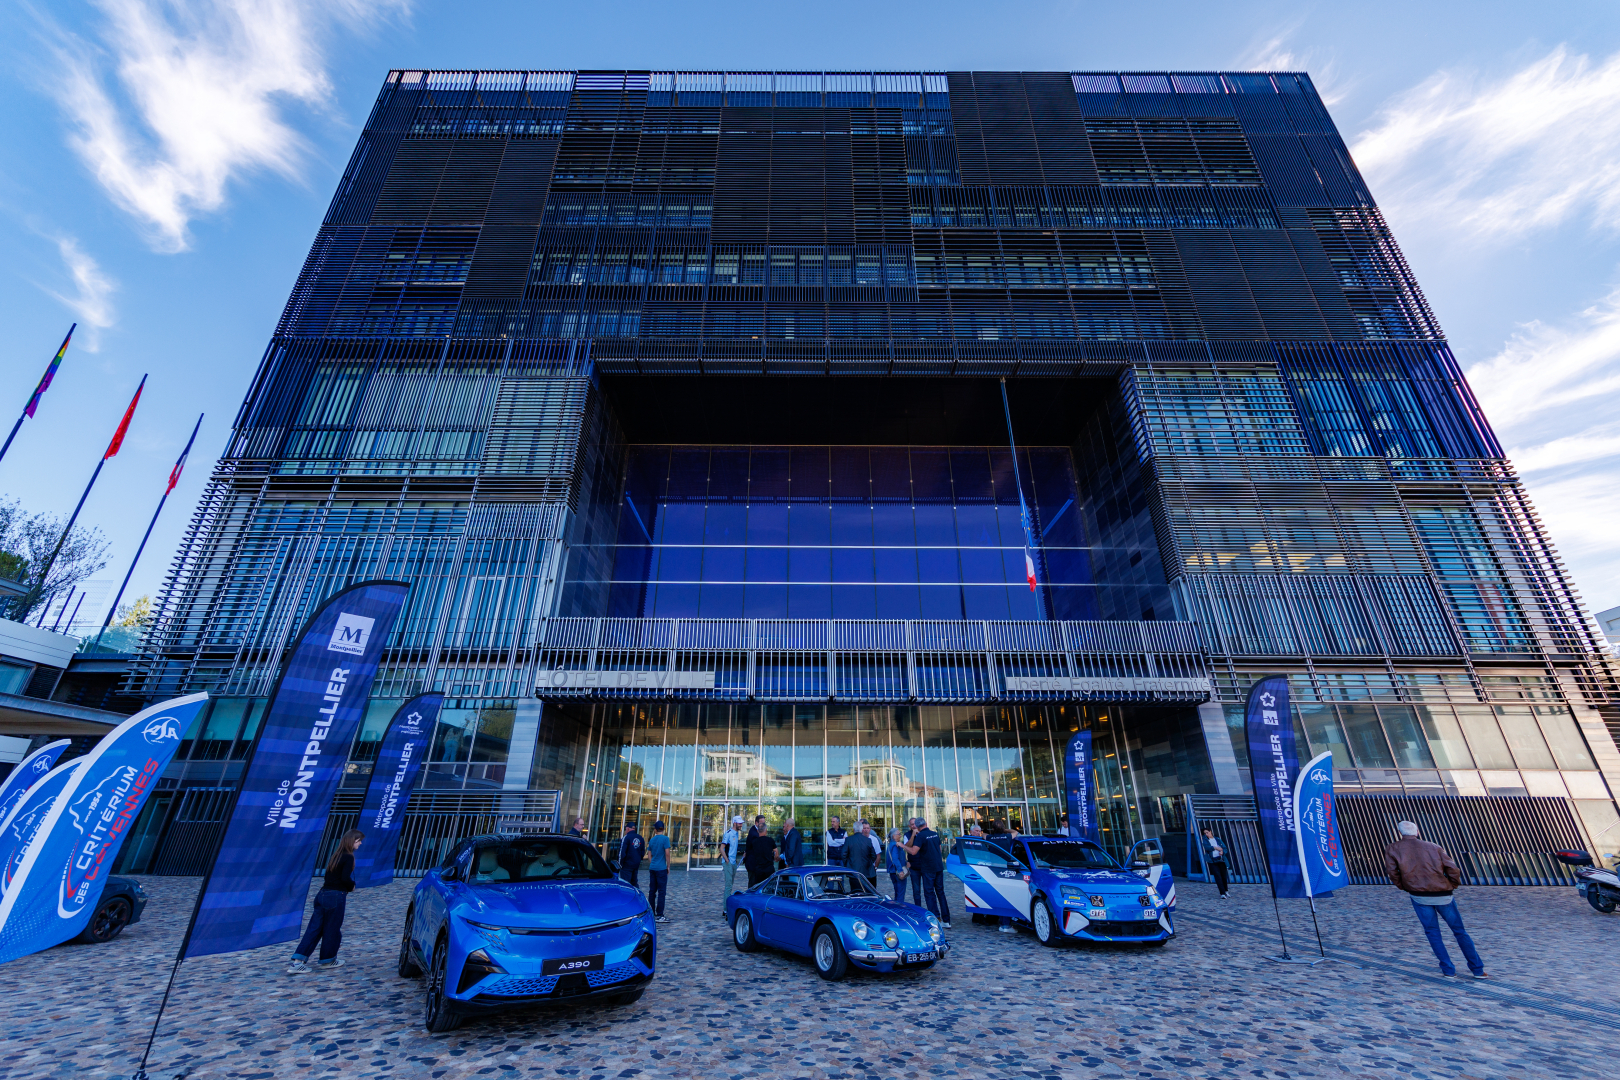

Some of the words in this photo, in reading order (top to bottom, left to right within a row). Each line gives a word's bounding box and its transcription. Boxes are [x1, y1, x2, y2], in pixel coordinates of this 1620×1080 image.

[535, 664, 609, 688] HÔTEL
[616, 670, 648, 688] DE
[653, 670, 716, 689] VILLE
[1132, 677, 1210, 691] Fraternité
[279, 667, 350, 829] MONTPELLIER
[91, 791, 103, 811] 1954
[380, 742, 414, 829] MONTPELLIER
[1078, 766, 1089, 827] MONTPELLIER
[1270, 734, 1295, 832] MONTPELLIER
[1274, 786, 1280, 796] et
[264, 798, 284, 827] Ville
[277, 779, 291, 797] de
[373, 792, 389, 829] Métropole
[384, 783, 392, 794] de
[1275, 795, 1286, 831] Métropole
[1315, 797, 1329, 852] CRITÉRIUM
[74, 881, 90, 904] DES
[549, 934, 602, 944] ALPINE
[558, 960, 591, 970] A390
